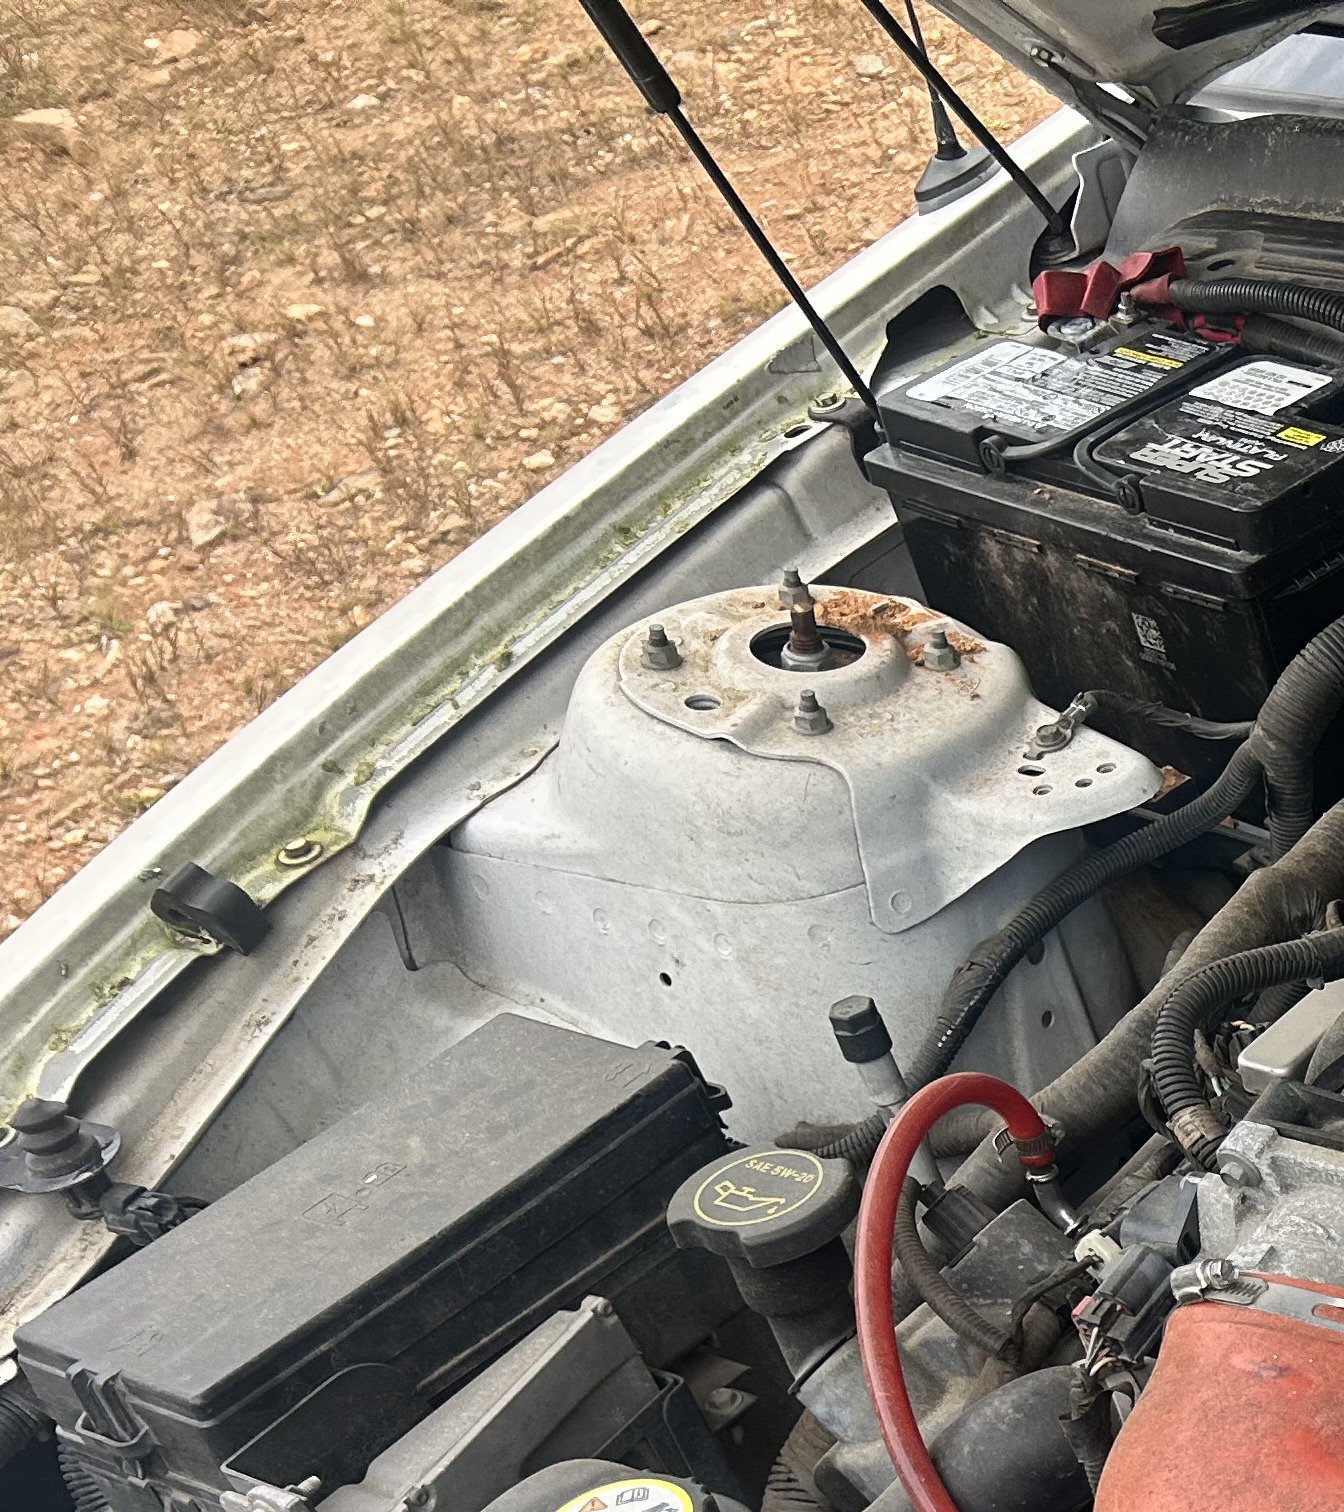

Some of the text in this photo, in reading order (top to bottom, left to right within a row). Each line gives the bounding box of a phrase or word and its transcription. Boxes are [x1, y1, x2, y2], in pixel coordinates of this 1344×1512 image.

[1145, 434, 1274, 477] START
[1191, 427, 1288, 461] PLATINUM
[1129, 446, 1239, 484] SUPER
[745, 1159, 816, 1183] SAE 5W-20
